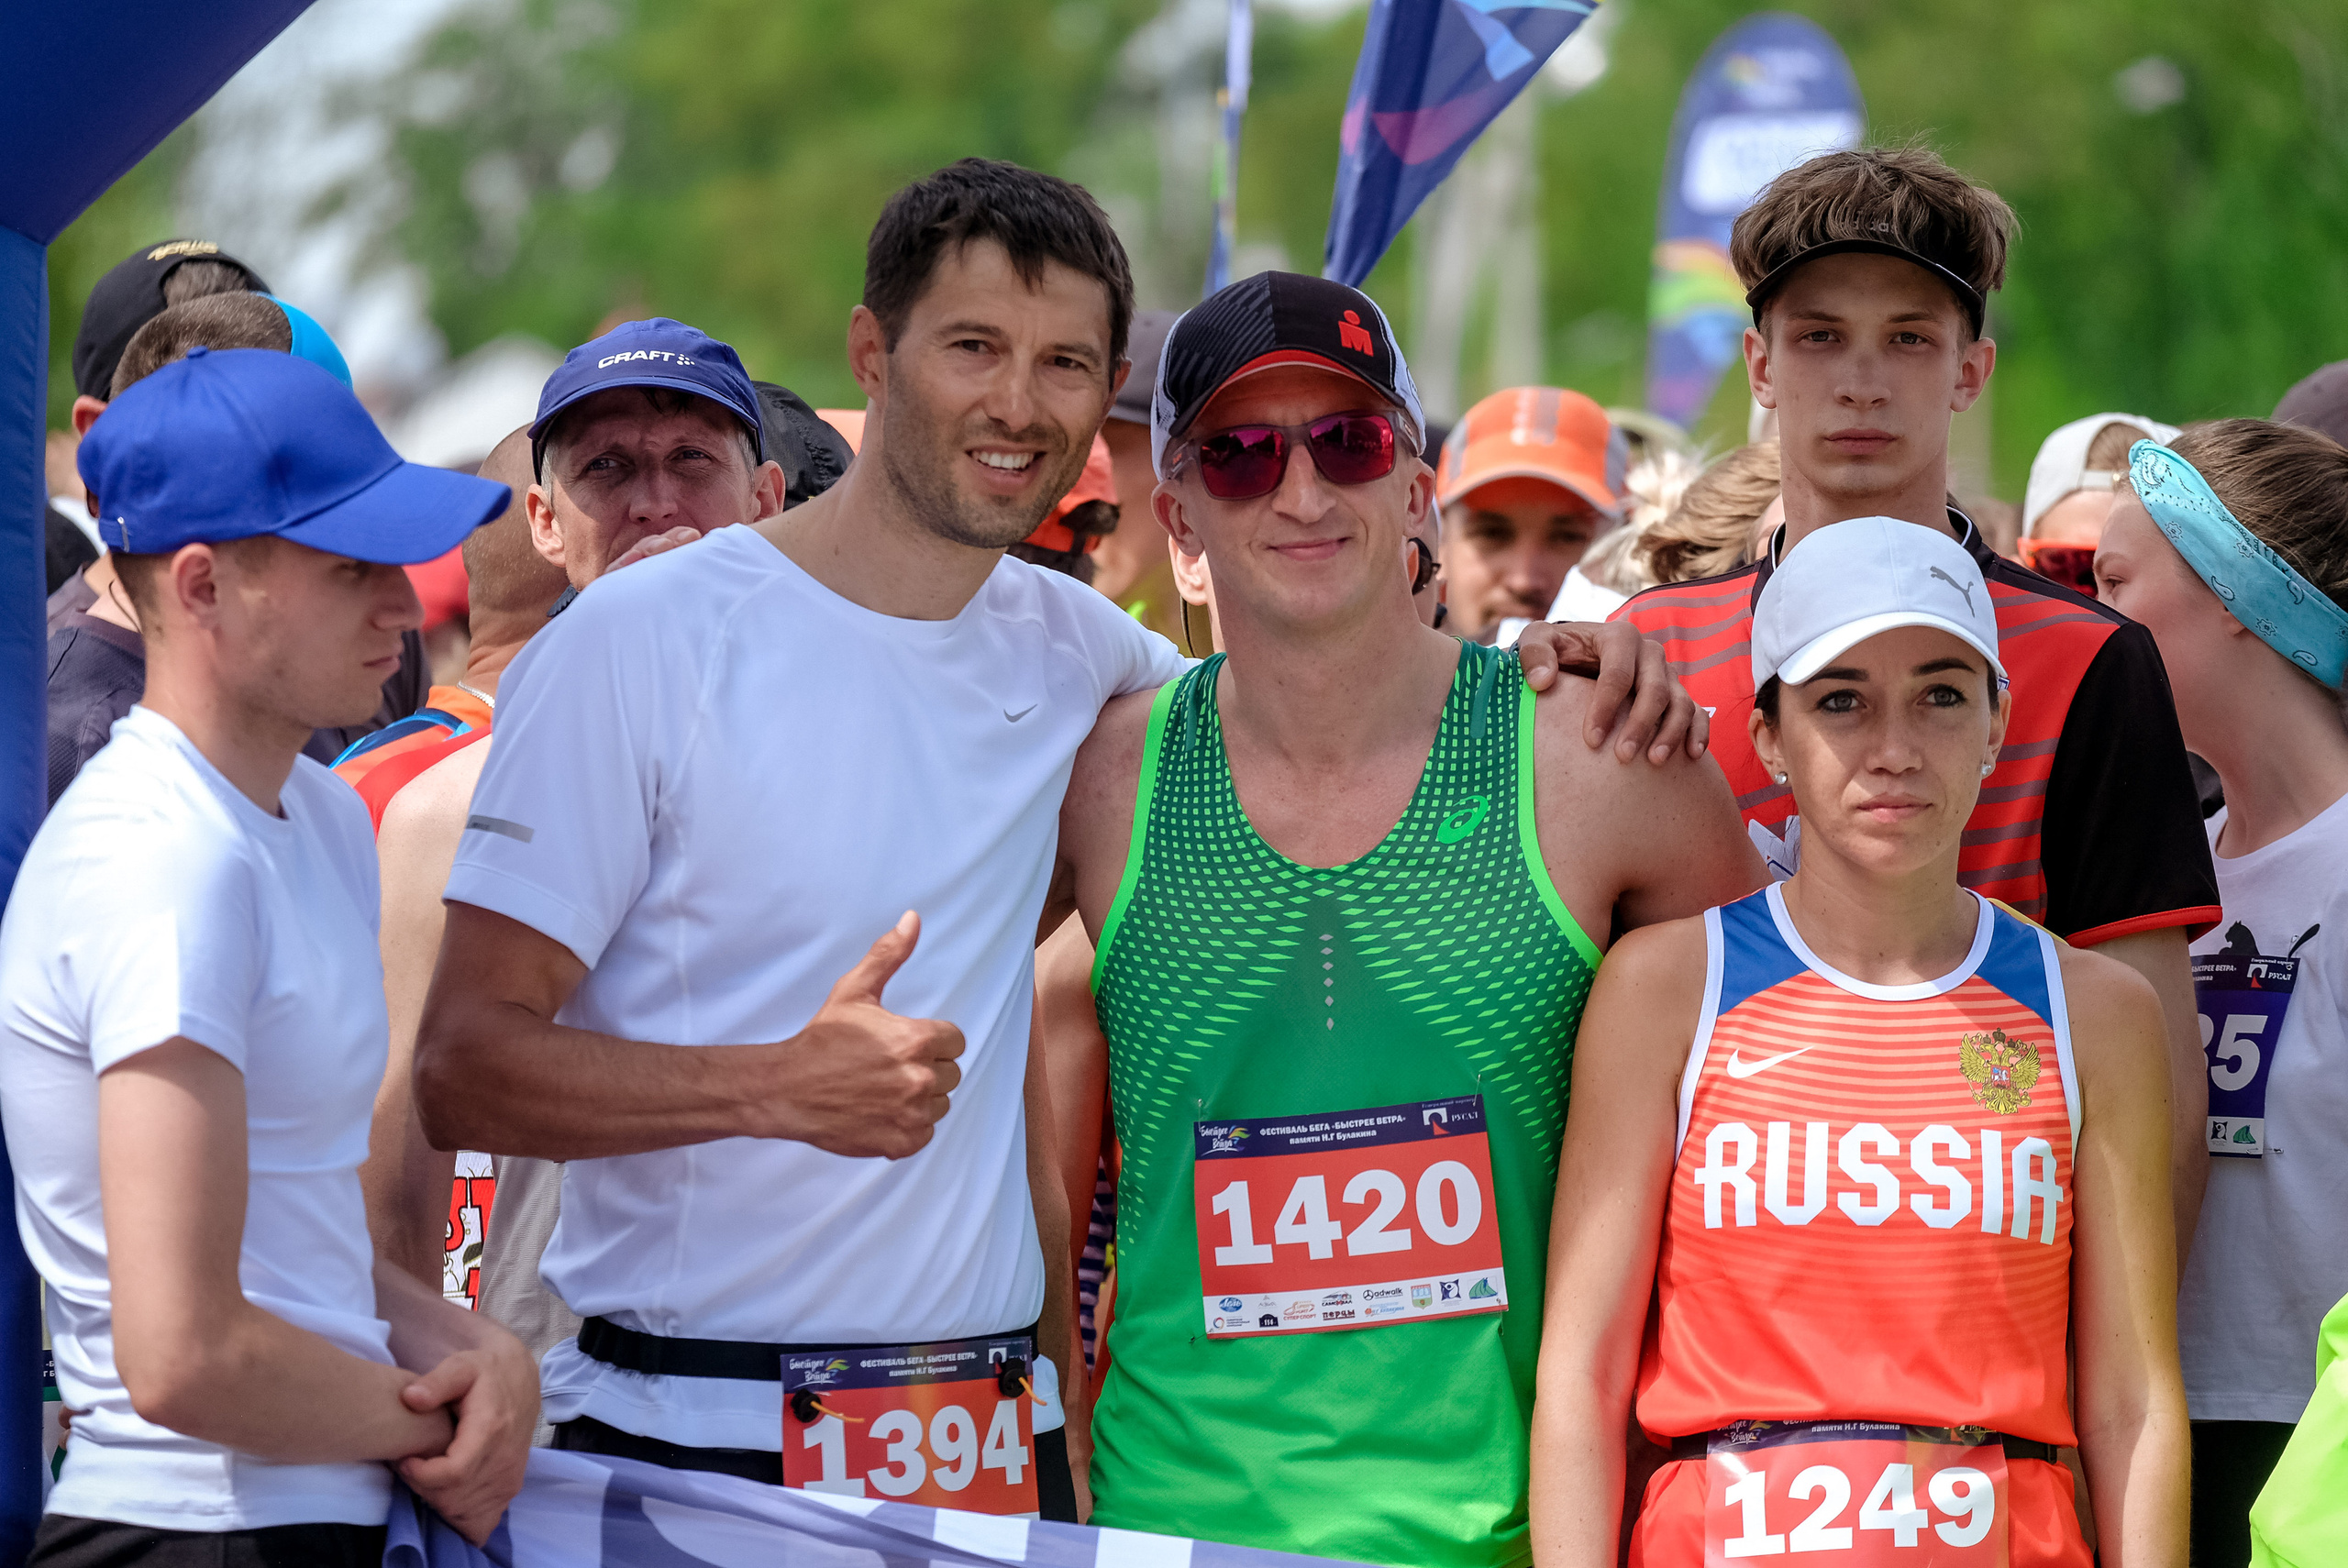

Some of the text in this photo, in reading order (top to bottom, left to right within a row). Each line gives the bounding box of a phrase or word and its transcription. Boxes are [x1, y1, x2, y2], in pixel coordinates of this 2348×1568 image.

[598, 349, 676, 370] CRAFT
[1259, 1124, 1308, 1137] ФЕСТИВАЛЬ
[1309, 1122, 1330, 1132] БЕГА
[1289, 1135, 1321, 1145] памяти
[1336, 1129, 1377, 1141] Булакина
[1694, 1121, 2064, 1246] RUSSIA
[1212, 1160, 1482, 1267] 1420
[1374, 1287, 1402, 1297] adwalk
[1323, 1309, 1355, 1320] перцы
[859, 1357, 906, 1369] ФЕСТИВАЛЬ
[1811, 1424, 1844, 1434] памяти
[1859, 1422, 1900, 1432] Булакина
[803, 1399, 1029, 1497] 1394
[1723, 1463, 1995, 1559] 1249
